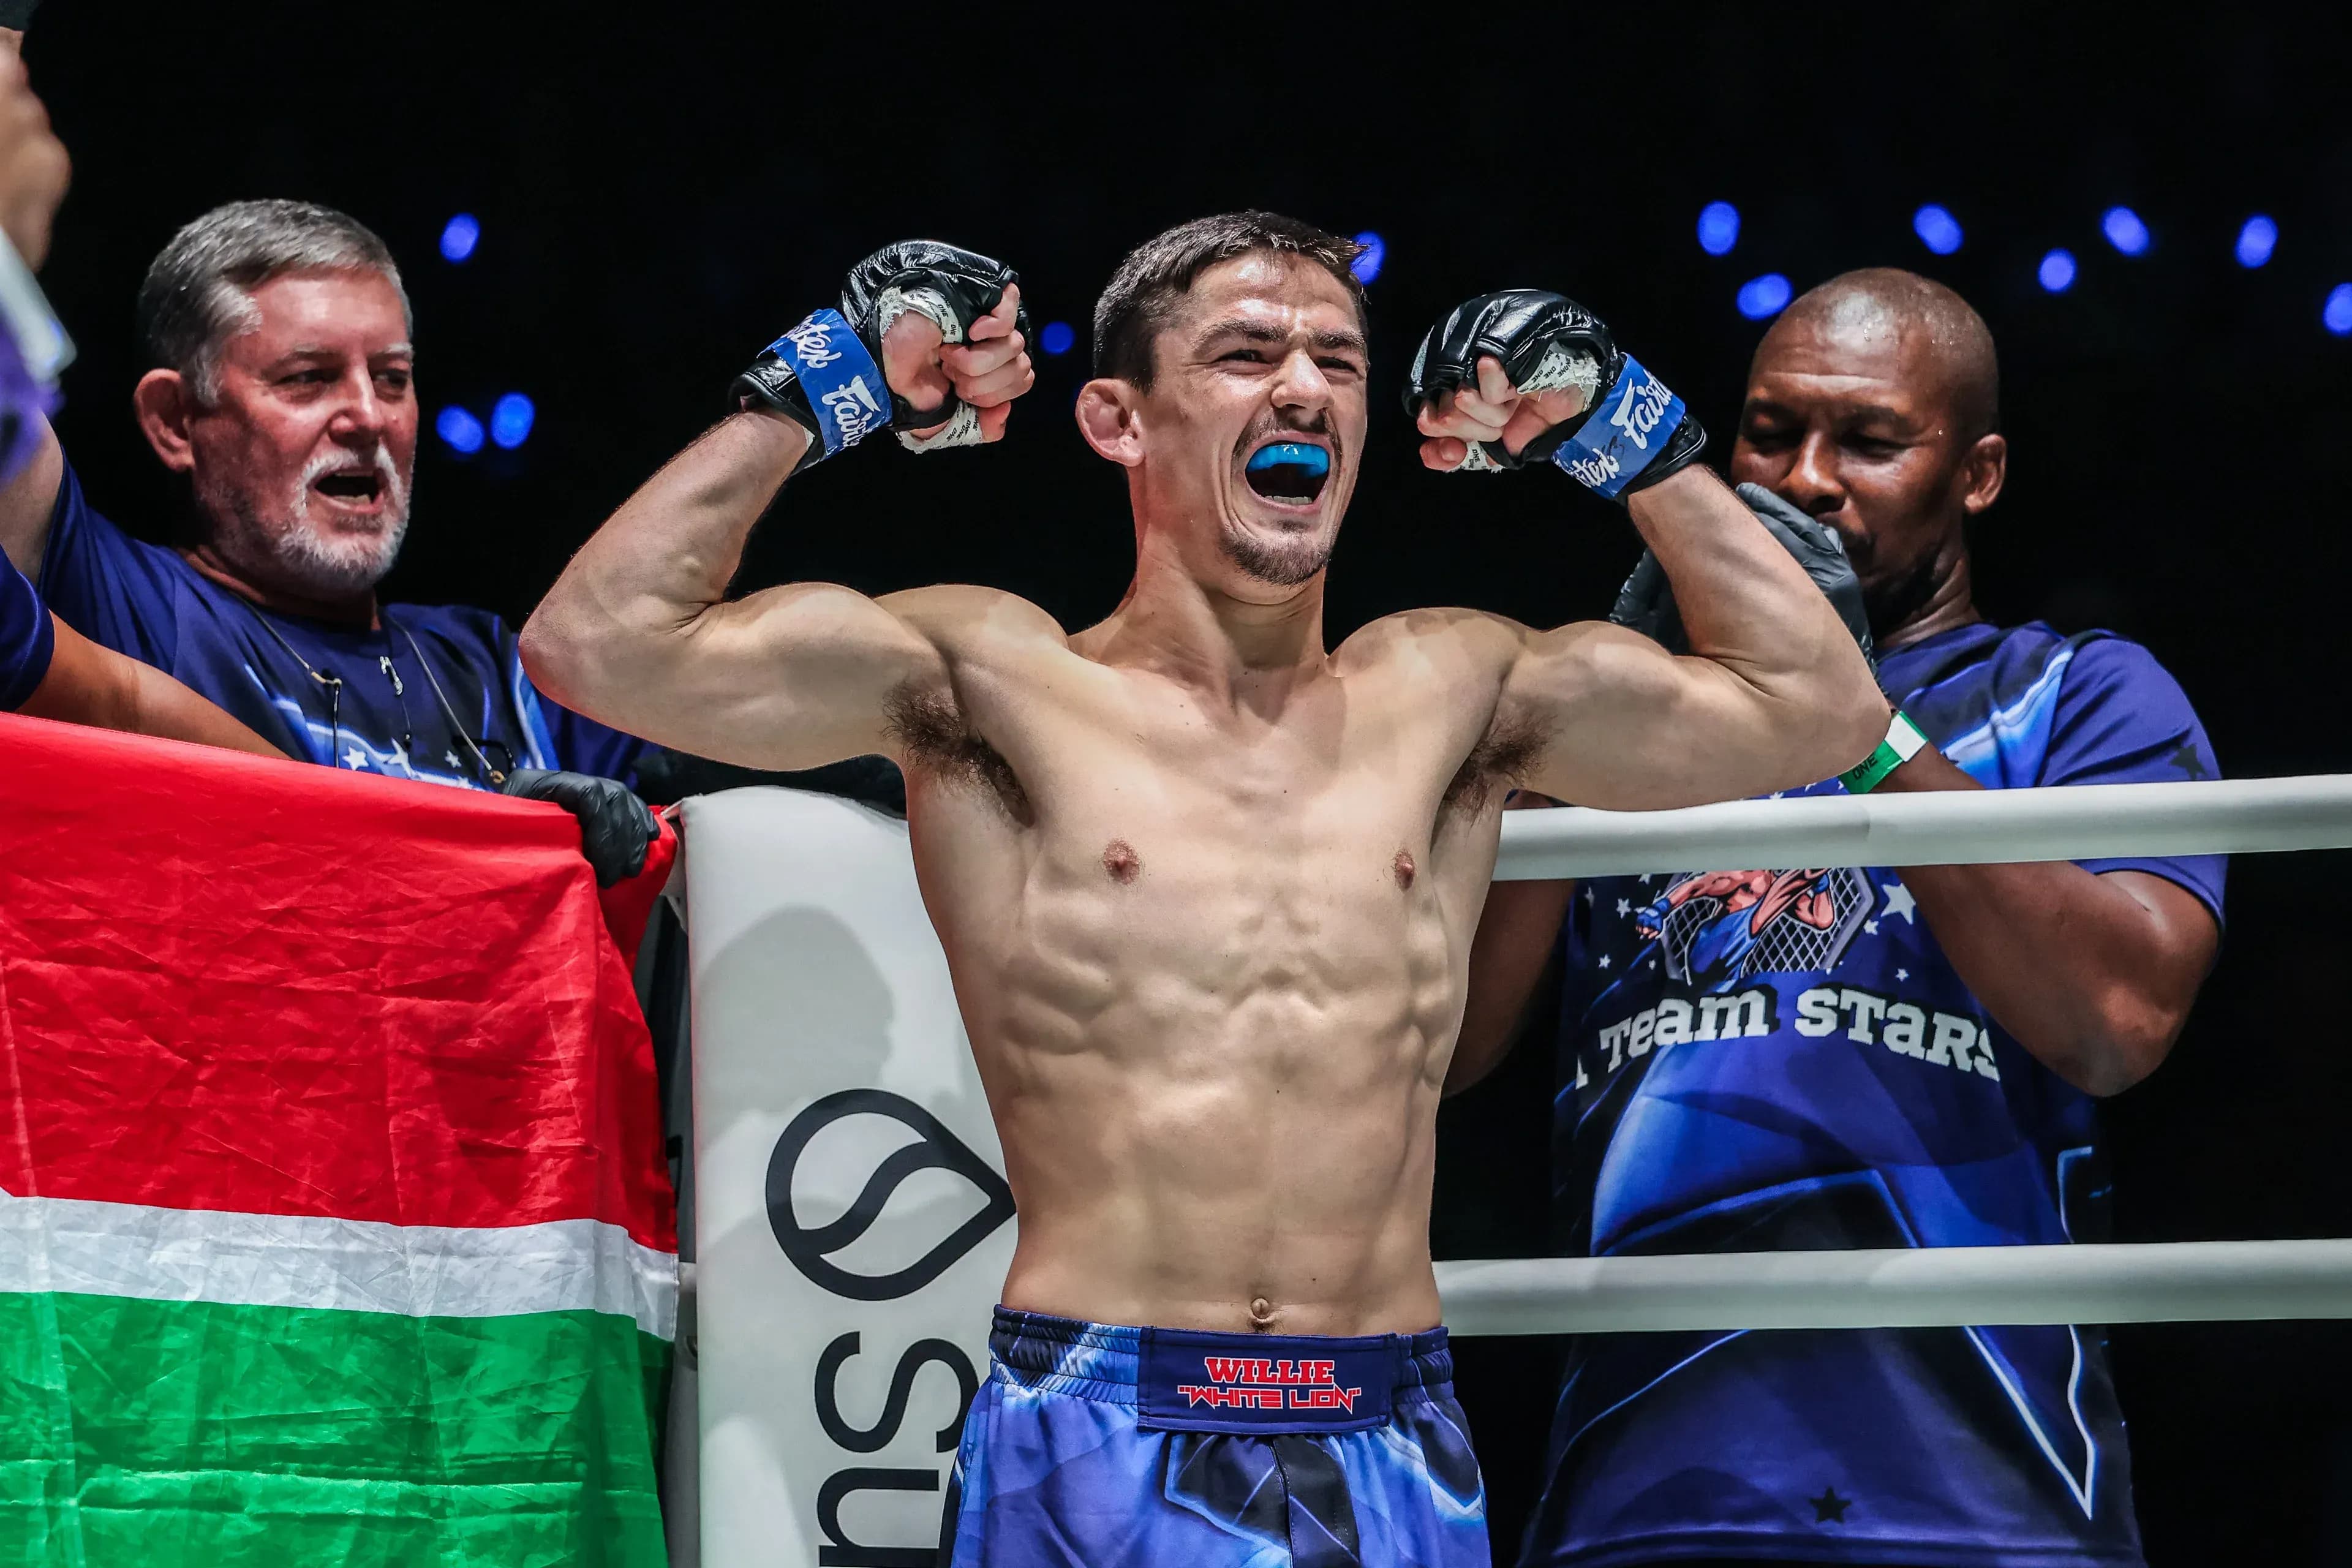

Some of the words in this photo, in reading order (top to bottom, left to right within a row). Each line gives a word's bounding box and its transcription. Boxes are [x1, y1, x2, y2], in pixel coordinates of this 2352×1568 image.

[938, 304, 949, 318] ONE
[1531, 369, 1544, 383] ONE
[1544, 366, 1556, 379] ONE
[946, 428, 957, 442] ONE
[956, 424, 966, 440] ONE
[1472, 449, 1480, 462] ONE
[1852, 754, 1878, 780] ONE
[1204, 1357, 1335, 1384] WILLIE
